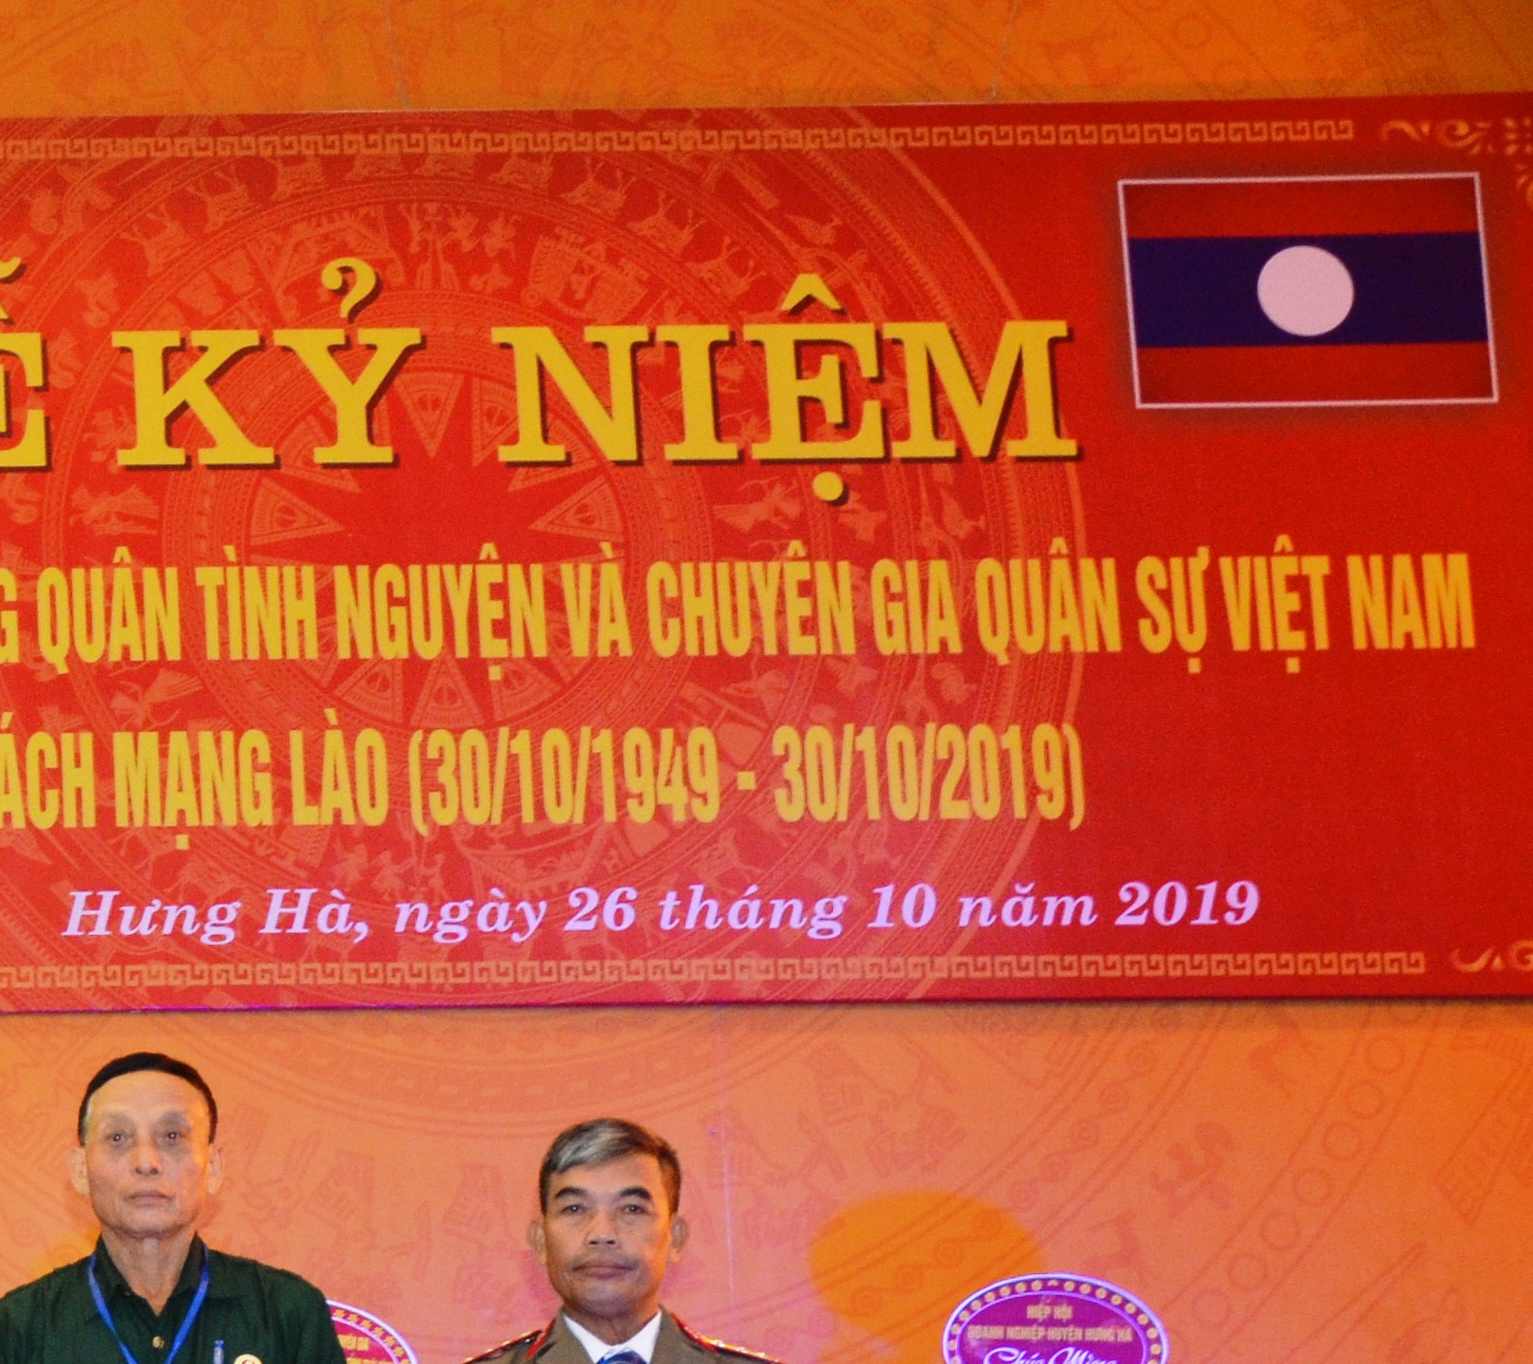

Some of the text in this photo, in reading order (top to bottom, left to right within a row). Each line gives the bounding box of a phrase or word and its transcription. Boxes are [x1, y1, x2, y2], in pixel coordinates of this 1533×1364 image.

[115, 257, 423, 467] KỶ
[491, 274, 1079, 503] NIỆM
[36, 547, 181, 675] QUÂN
[195, 544, 319, 661] TÌNH
[334, 542, 548, 680] NGUYỆN
[560, 541, 633, 658] VÀ
[645, 540, 857, 658] CHUYÊN
[870, 557, 963, 655] GIA
[974, 536, 1122, 666] QUÂN
[1134, 546, 1211, 674] SỰ
[1219, 534, 1331, 674] VIỆT
[1346, 552, 1477, 651] NAM
[112, 728, 273, 851] MẠNG
[290, 708, 388, 828] LÀO
[408, 725, 721, 837] (30/10/1949
[737, 770, 756, 791] -
[772, 721, 1086, 832] 30/10/2019)
[60, 880, 1262, 945] Hưng Hà, ngày 26 tháng 10 năm 2019
